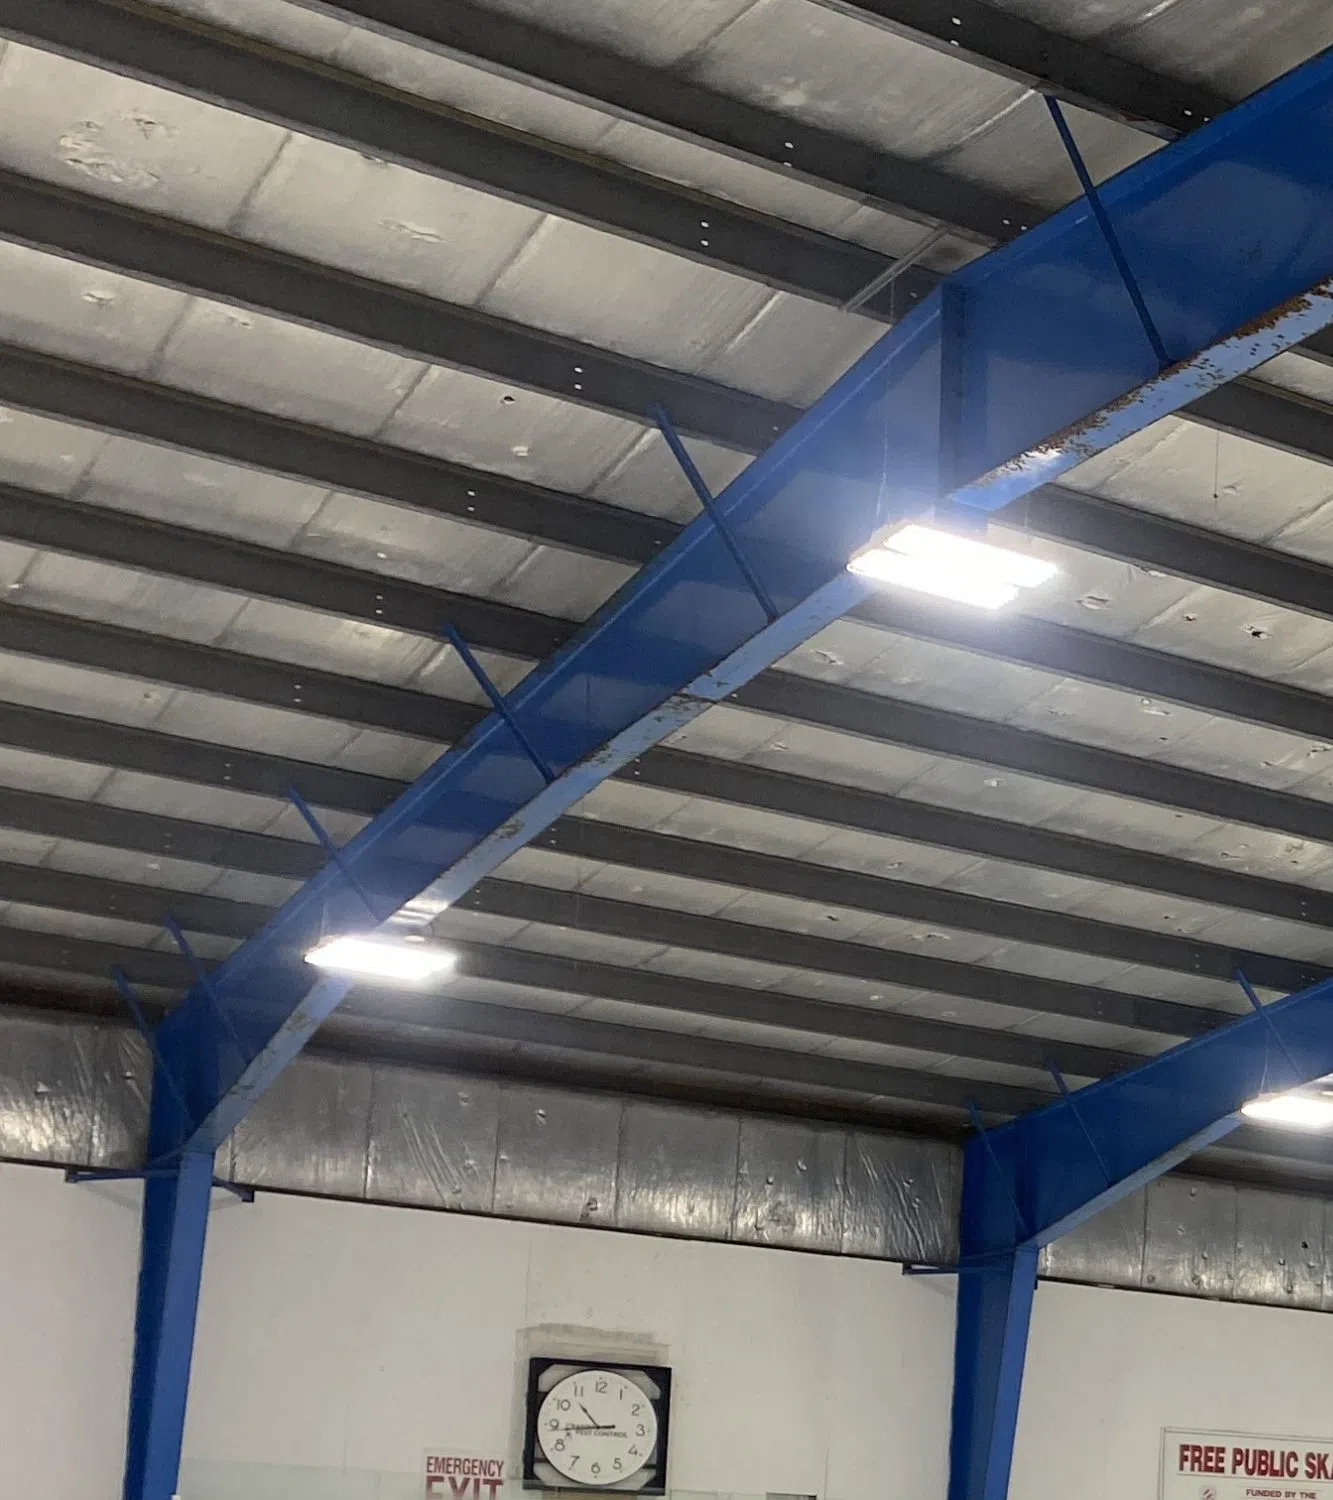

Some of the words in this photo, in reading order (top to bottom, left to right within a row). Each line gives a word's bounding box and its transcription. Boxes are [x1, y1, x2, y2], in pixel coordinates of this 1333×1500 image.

[595, 1381, 607, 1393] 12
[556, 1399, 571, 1411] 10
[631, 1404, 640, 1416] 2
[549, 1419, 559, 1430] 9
[635, 1424, 645, 1436] 3
[555, 1439, 565, 1451] 8
[628, 1445, 638, 1455] 4
[427, 1456, 504, 1477] EMERGENCY
[571, 1456, 580, 1468] 7
[613, 1458, 622, 1470] 5
[1179, 1444, 1226, 1473] FREE
[1231, 1448, 1299, 1477] PUBLIC
[591, 1462, 600, 1473] 6
[1246, 1489, 1282, 1498] FUNDED
